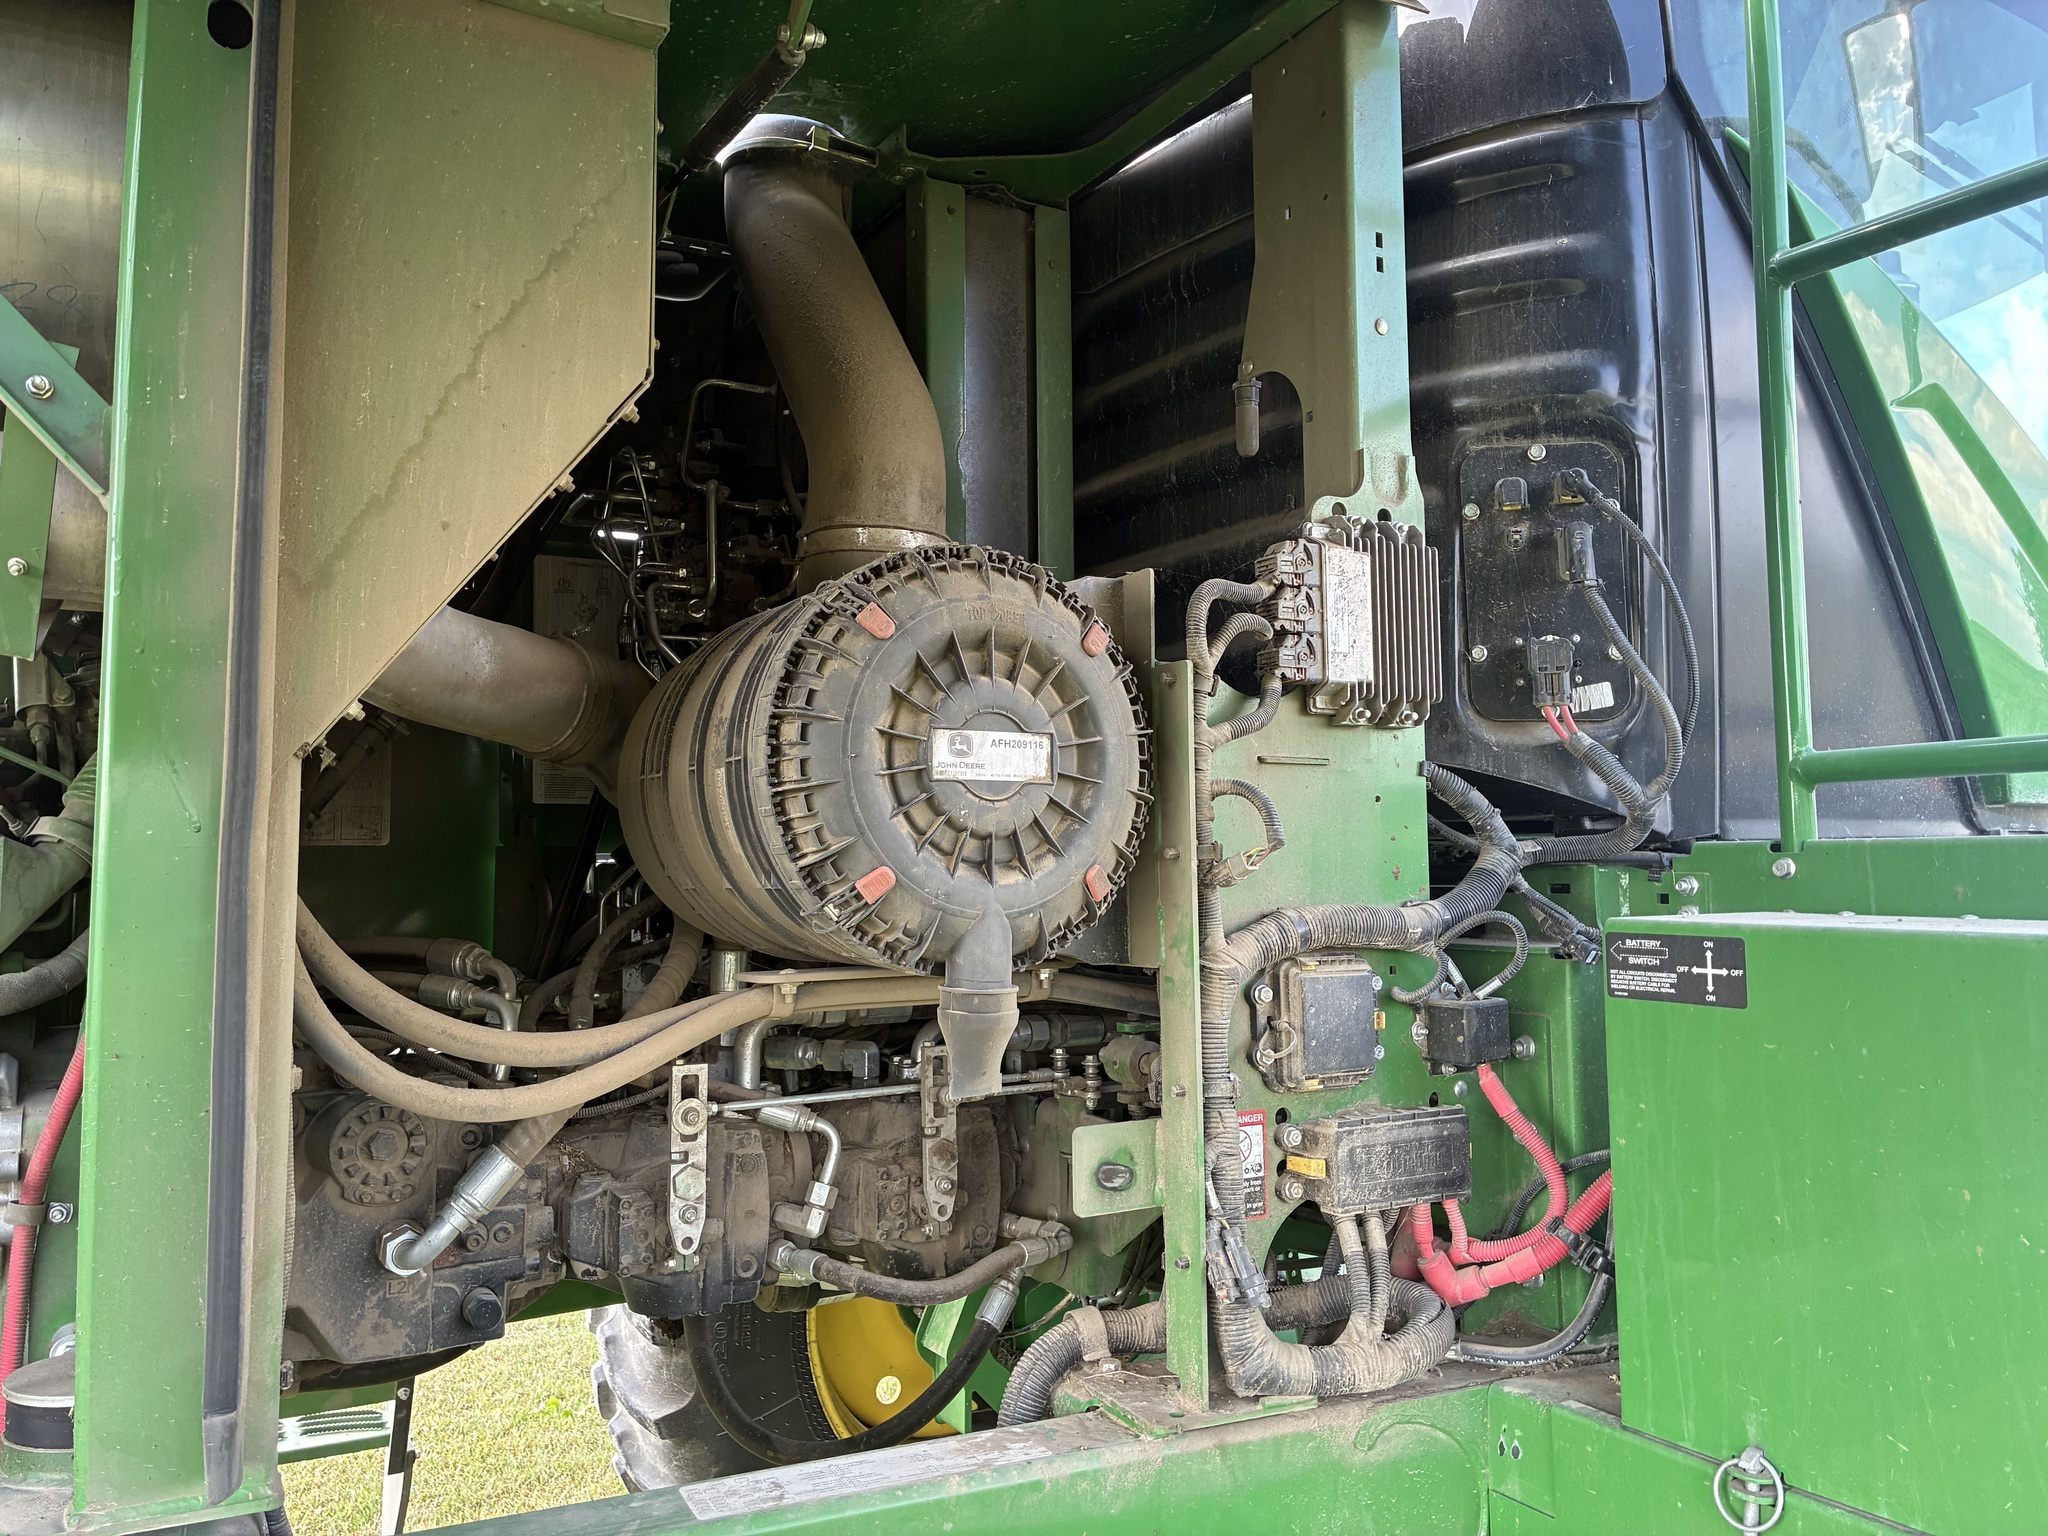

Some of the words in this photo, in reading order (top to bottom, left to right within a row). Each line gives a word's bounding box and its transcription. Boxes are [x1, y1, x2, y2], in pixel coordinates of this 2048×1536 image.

[990, 738, 1044, 750] AFH209116
[935, 760, 958, 769] JOHN
[958, 761, 986, 770] DEERE
[1625, 939, 1661, 948] BATTERY
[1703, 940, 1714, 948] ON
[1628, 957, 1660, 966] SWITCH
[1676, 965, 1689, 973] OFF
[1730, 969, 1744, 977] OFF
[1705, 994, 1716, 1002] ON
[1238, 1113, 1263, 1123] ANGER
[388, 1280, 407, 1295] L2
